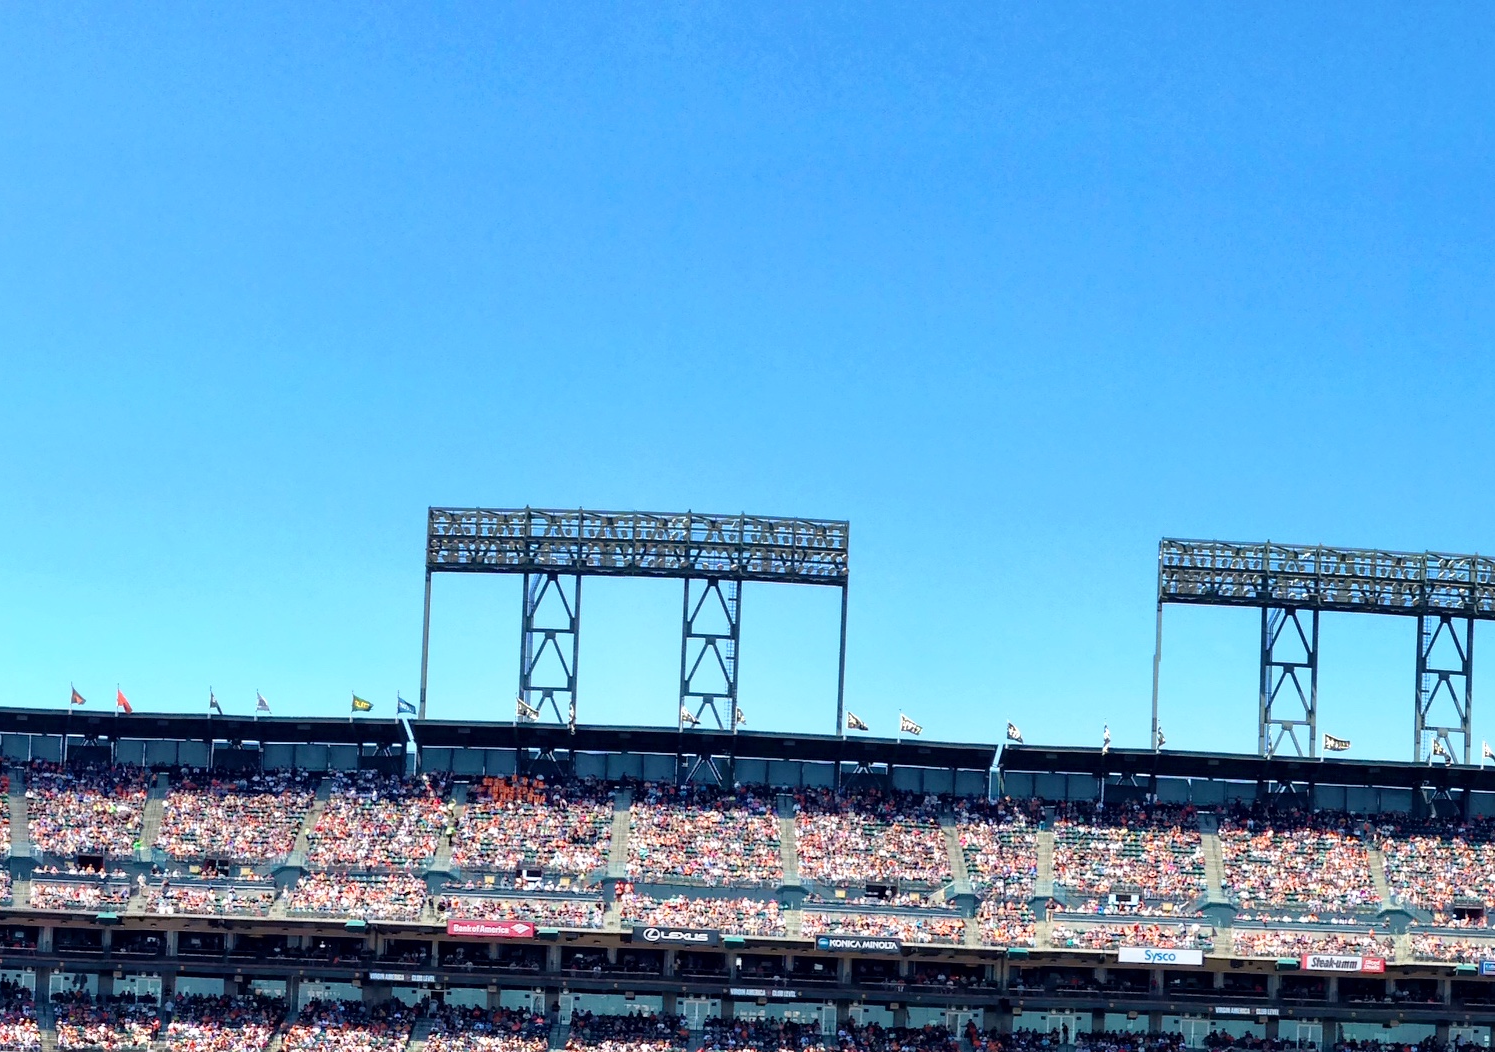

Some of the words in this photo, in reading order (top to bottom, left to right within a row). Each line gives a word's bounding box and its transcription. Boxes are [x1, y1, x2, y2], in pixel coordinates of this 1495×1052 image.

[660, 931, 709, 942] LEXUS
[829, 939, 861, 949] KONICA
[862, 940, 898, 950] MINOLTA
[1144, 949, 1176, 963] Sysco
[1311, 956, 1357, 970] Steak-umm
